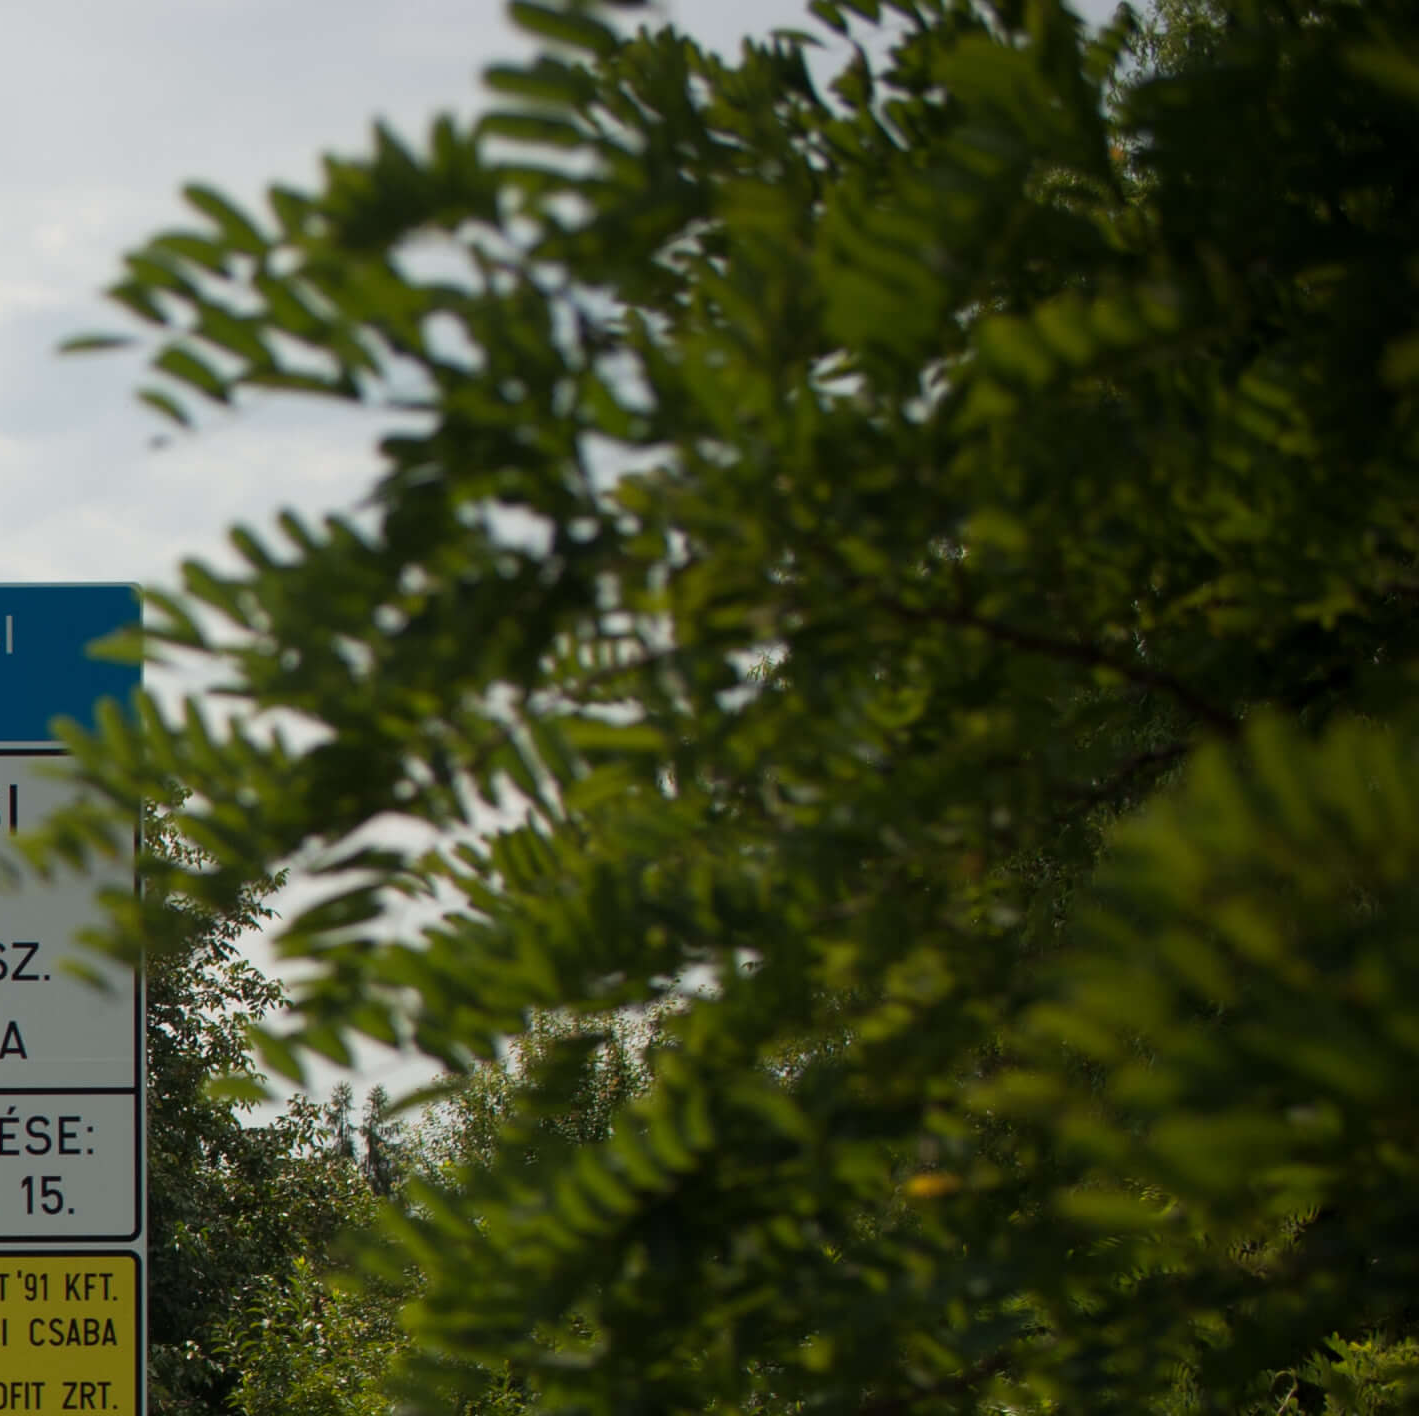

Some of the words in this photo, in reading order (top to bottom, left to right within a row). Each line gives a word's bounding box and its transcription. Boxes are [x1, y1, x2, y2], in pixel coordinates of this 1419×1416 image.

[22, 1176, 76, 1215] 15.
[65, 1273, 118, 1301] KFT.
[30, 1318, 117, 1346] CSABA
[62, 1382, 118, 1410] ZRT.
